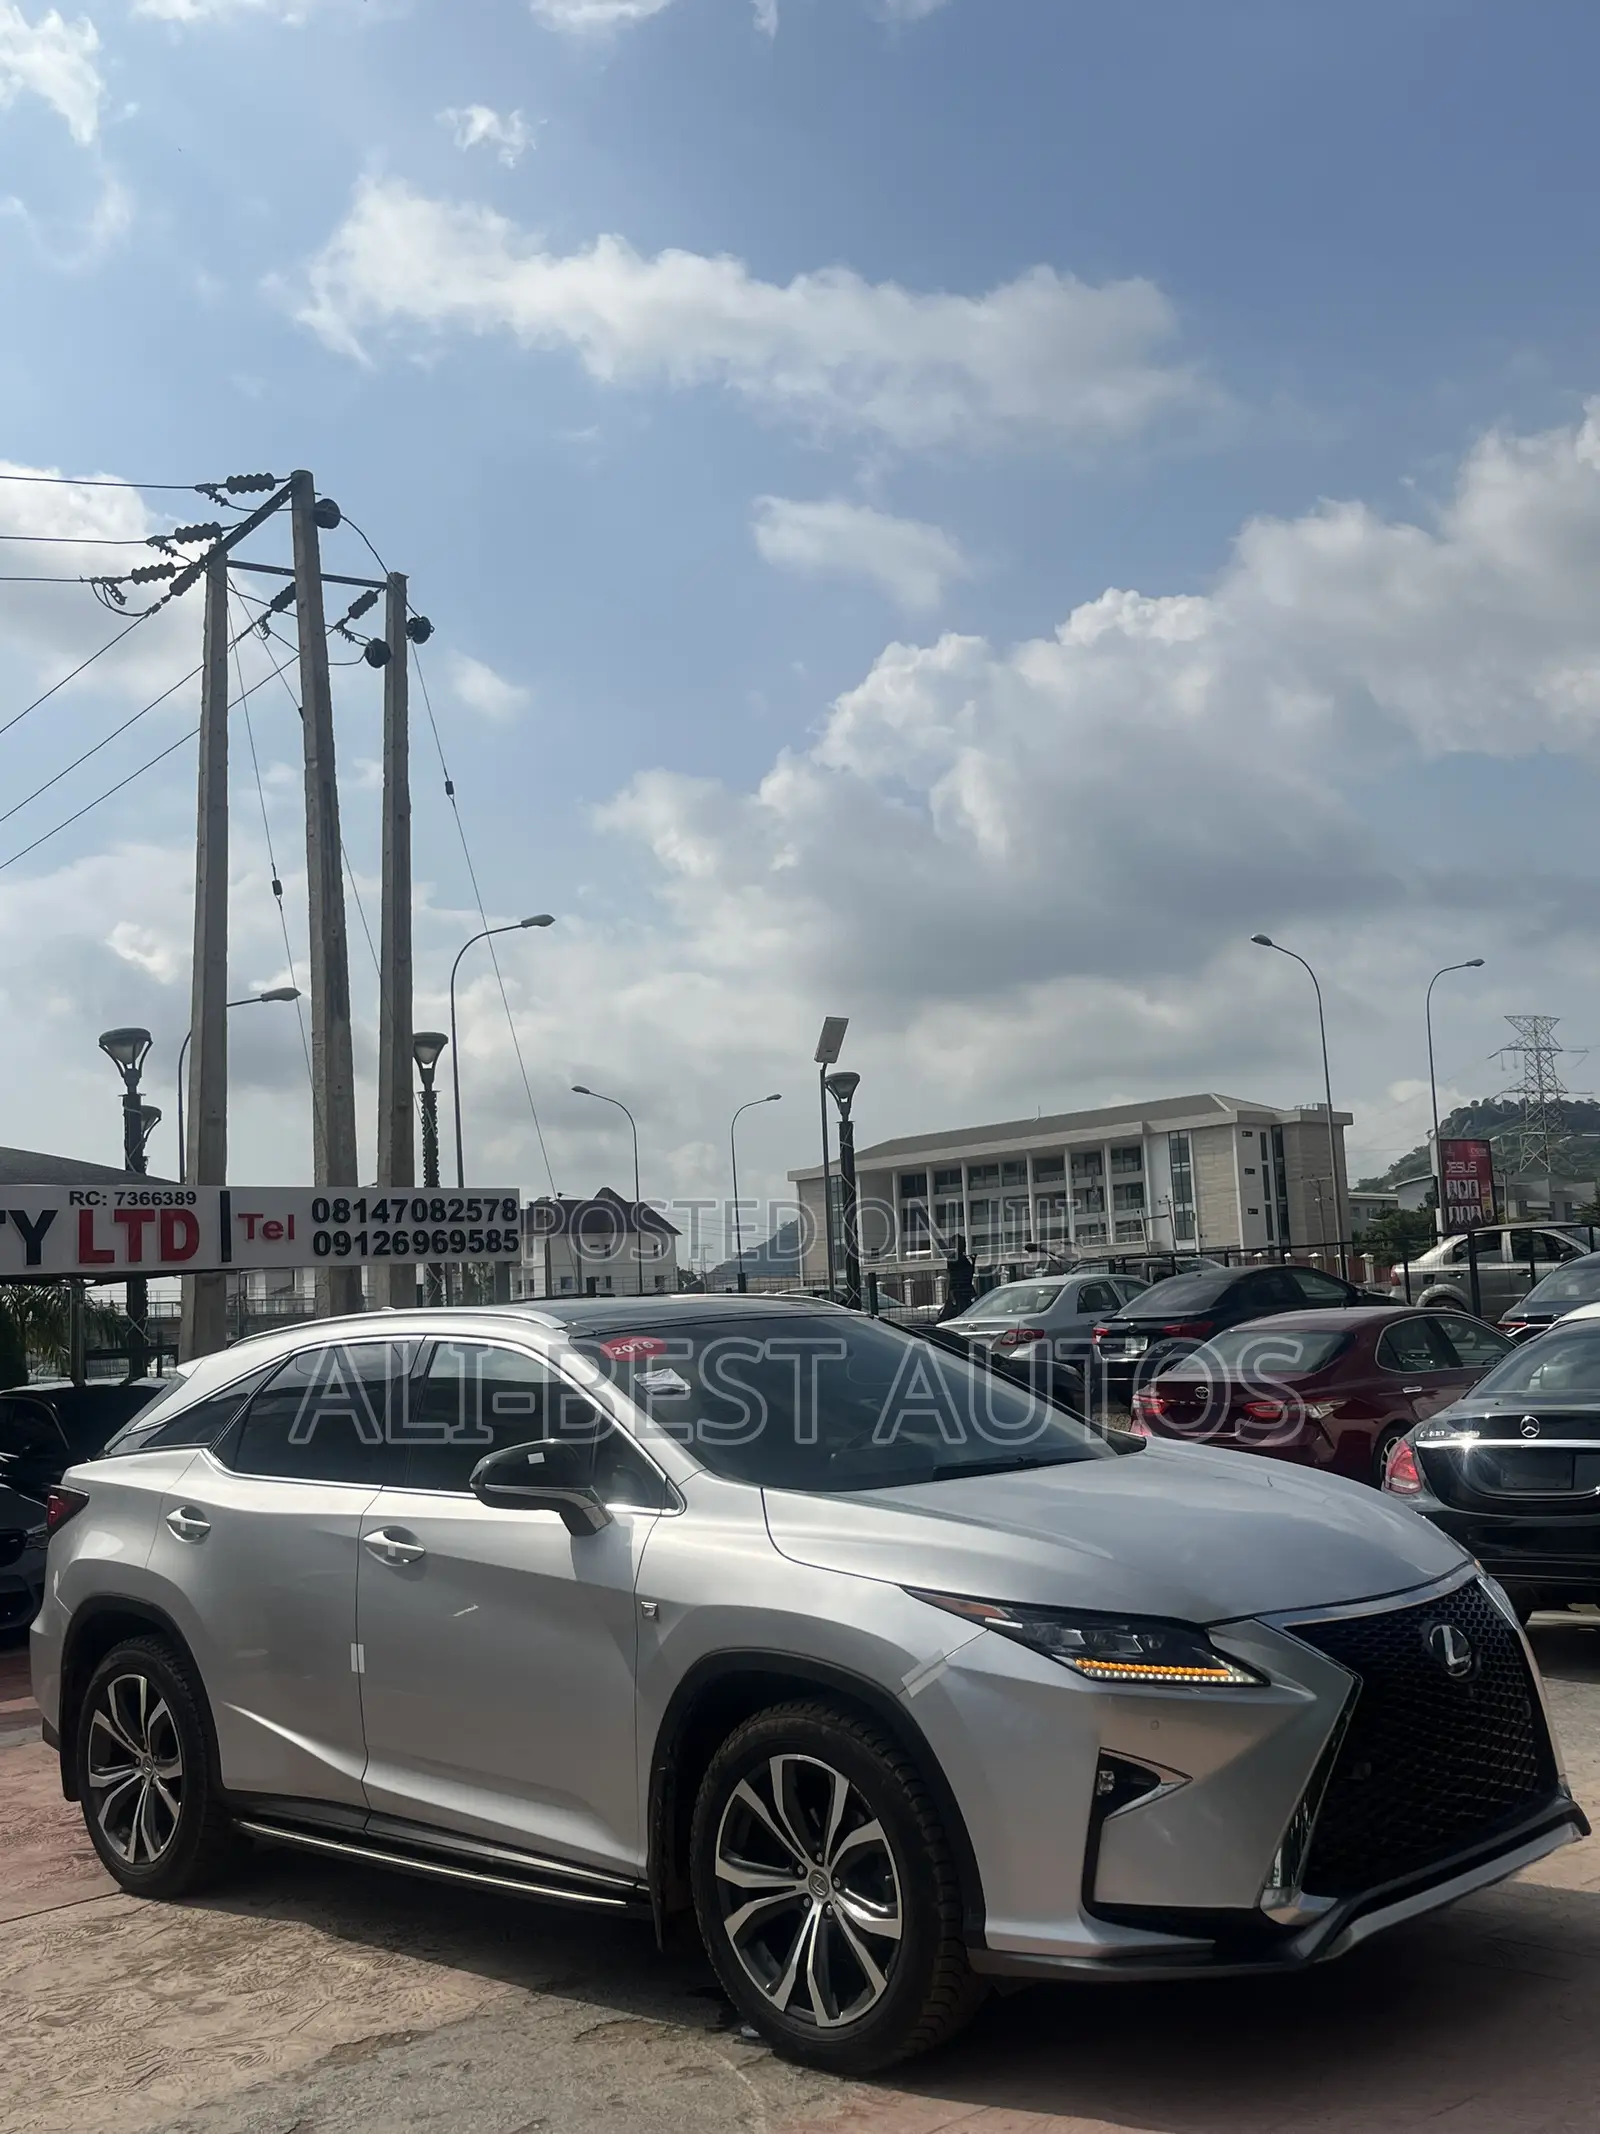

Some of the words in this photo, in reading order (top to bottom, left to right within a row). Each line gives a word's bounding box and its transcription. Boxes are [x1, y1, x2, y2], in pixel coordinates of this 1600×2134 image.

[1446, 1160, 1477, 1173] JESUS
[69, 1191, 107, 1206] RC:
[114, 1191, 197, 1206] 7366389
[312, 1198, 518, 1224] 08147082578
[0, 1209, 58, 1266] Y
[79, 1208, 200, 1264] LTD
[238, 1213, 295, 1241] Tel
[312, 1229, 519, 1256] 09126969585
